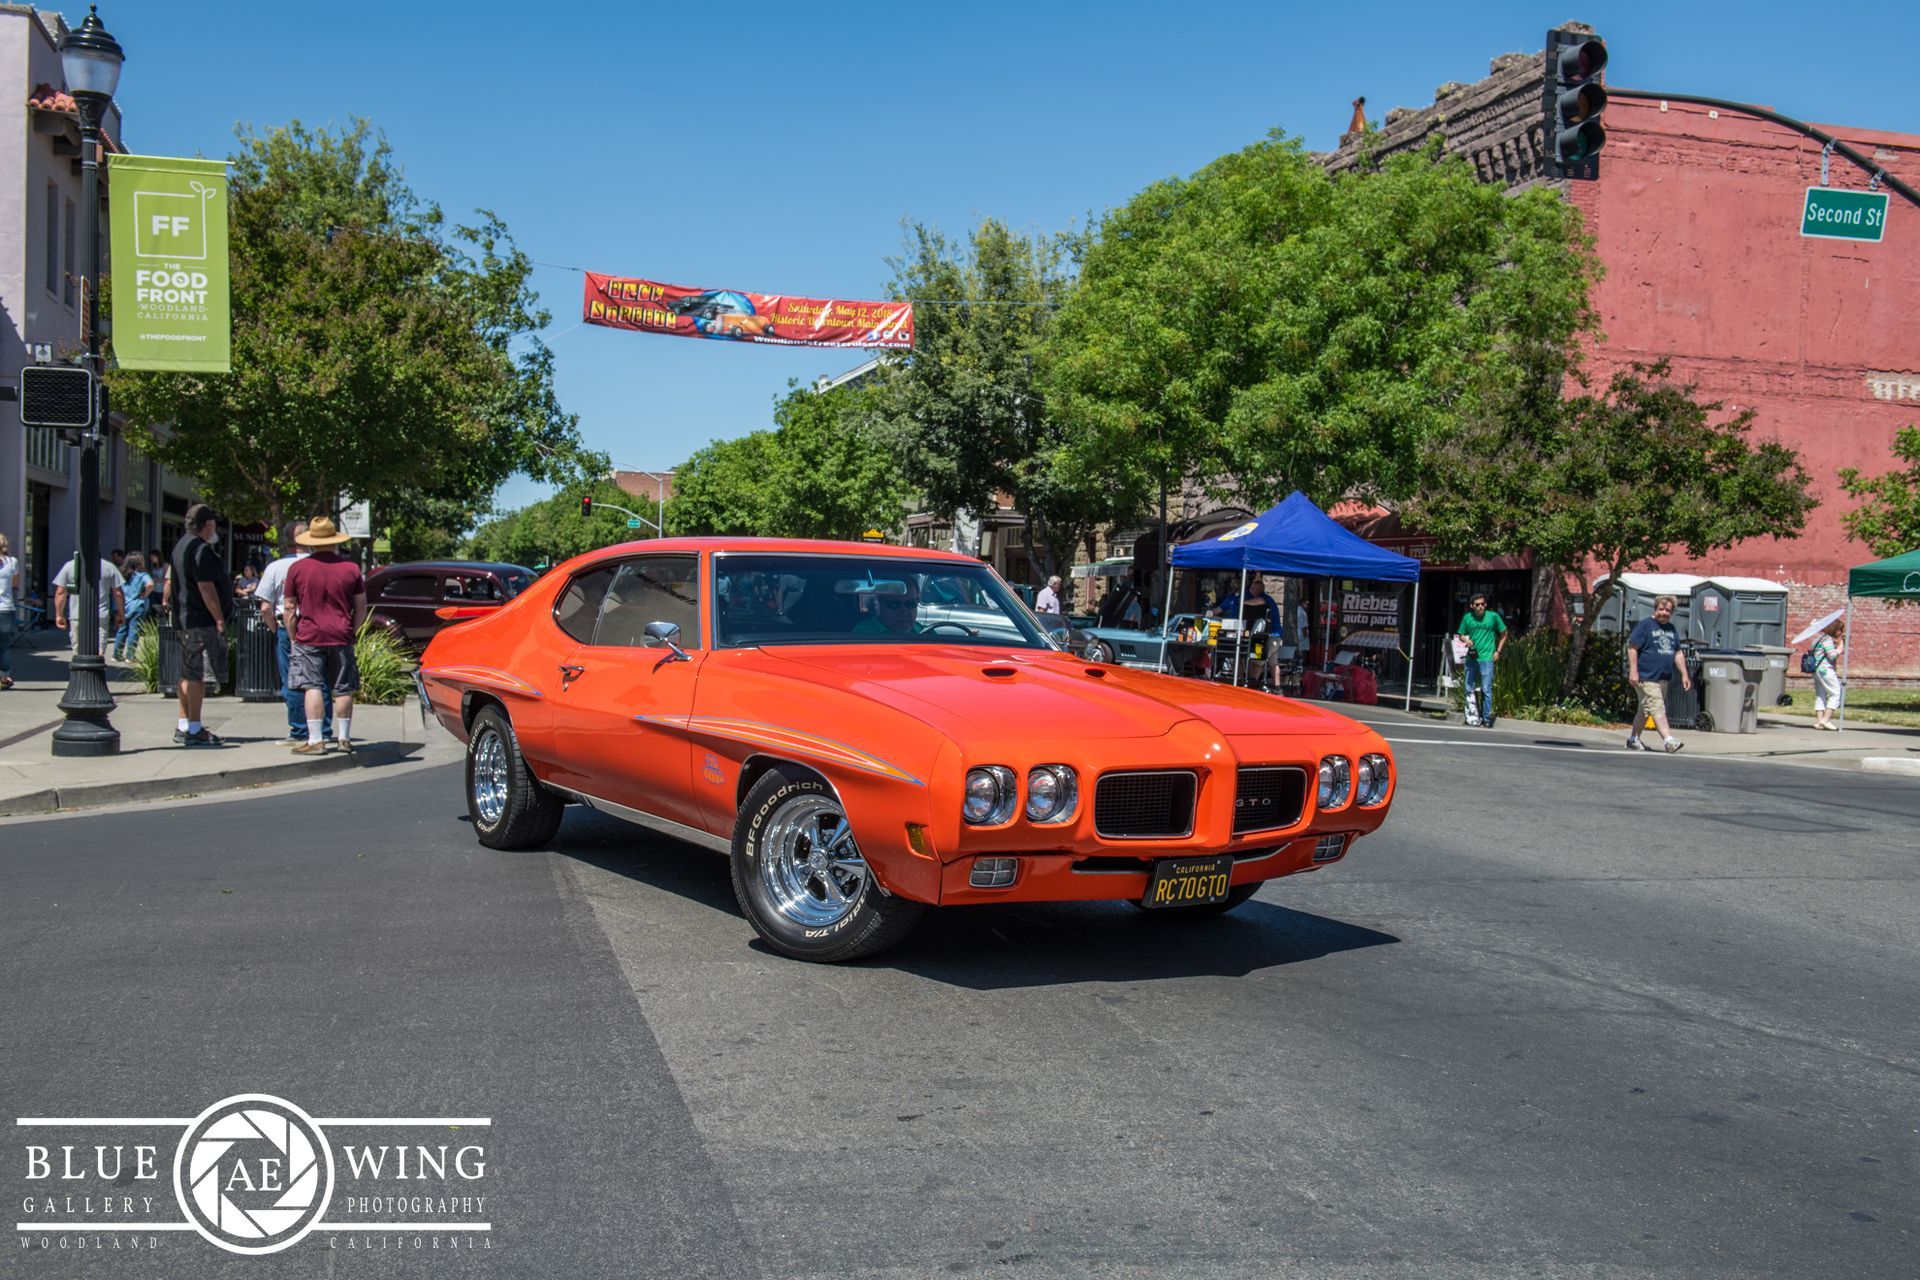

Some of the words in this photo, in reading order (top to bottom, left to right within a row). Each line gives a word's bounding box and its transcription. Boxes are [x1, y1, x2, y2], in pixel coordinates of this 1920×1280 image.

[1807, 203, 1862, 225] Second
[1865, 207, 1882, 227] St
[152, 215, 190, 237] FF
[136, 270, 208, 289] FOOD
[136, 288, 208, 304] FRONT
[610, 280, 664, 303] BACK
[137, 312, 208, 321] CALIFORNIA
[835, 305, 856, 317] May
[770, 312, 806, 326] Historic
[808, 316, 854, 329] Dntown
[139, 333, 207, 342] @THEFOODFRONT
[1342, 594, 1399, 611] Riebes
[1343, 614, 1369, 624] auto
[1370, 615, 1398, 627] parts
[1236, 798, 1271, 807] GTO
[746, 781, 823, 857] BFGoodrich
[1176, 864, 1215, 874] CALIFORNIA
[1155, 873, 1228, 902] RC70GTO
